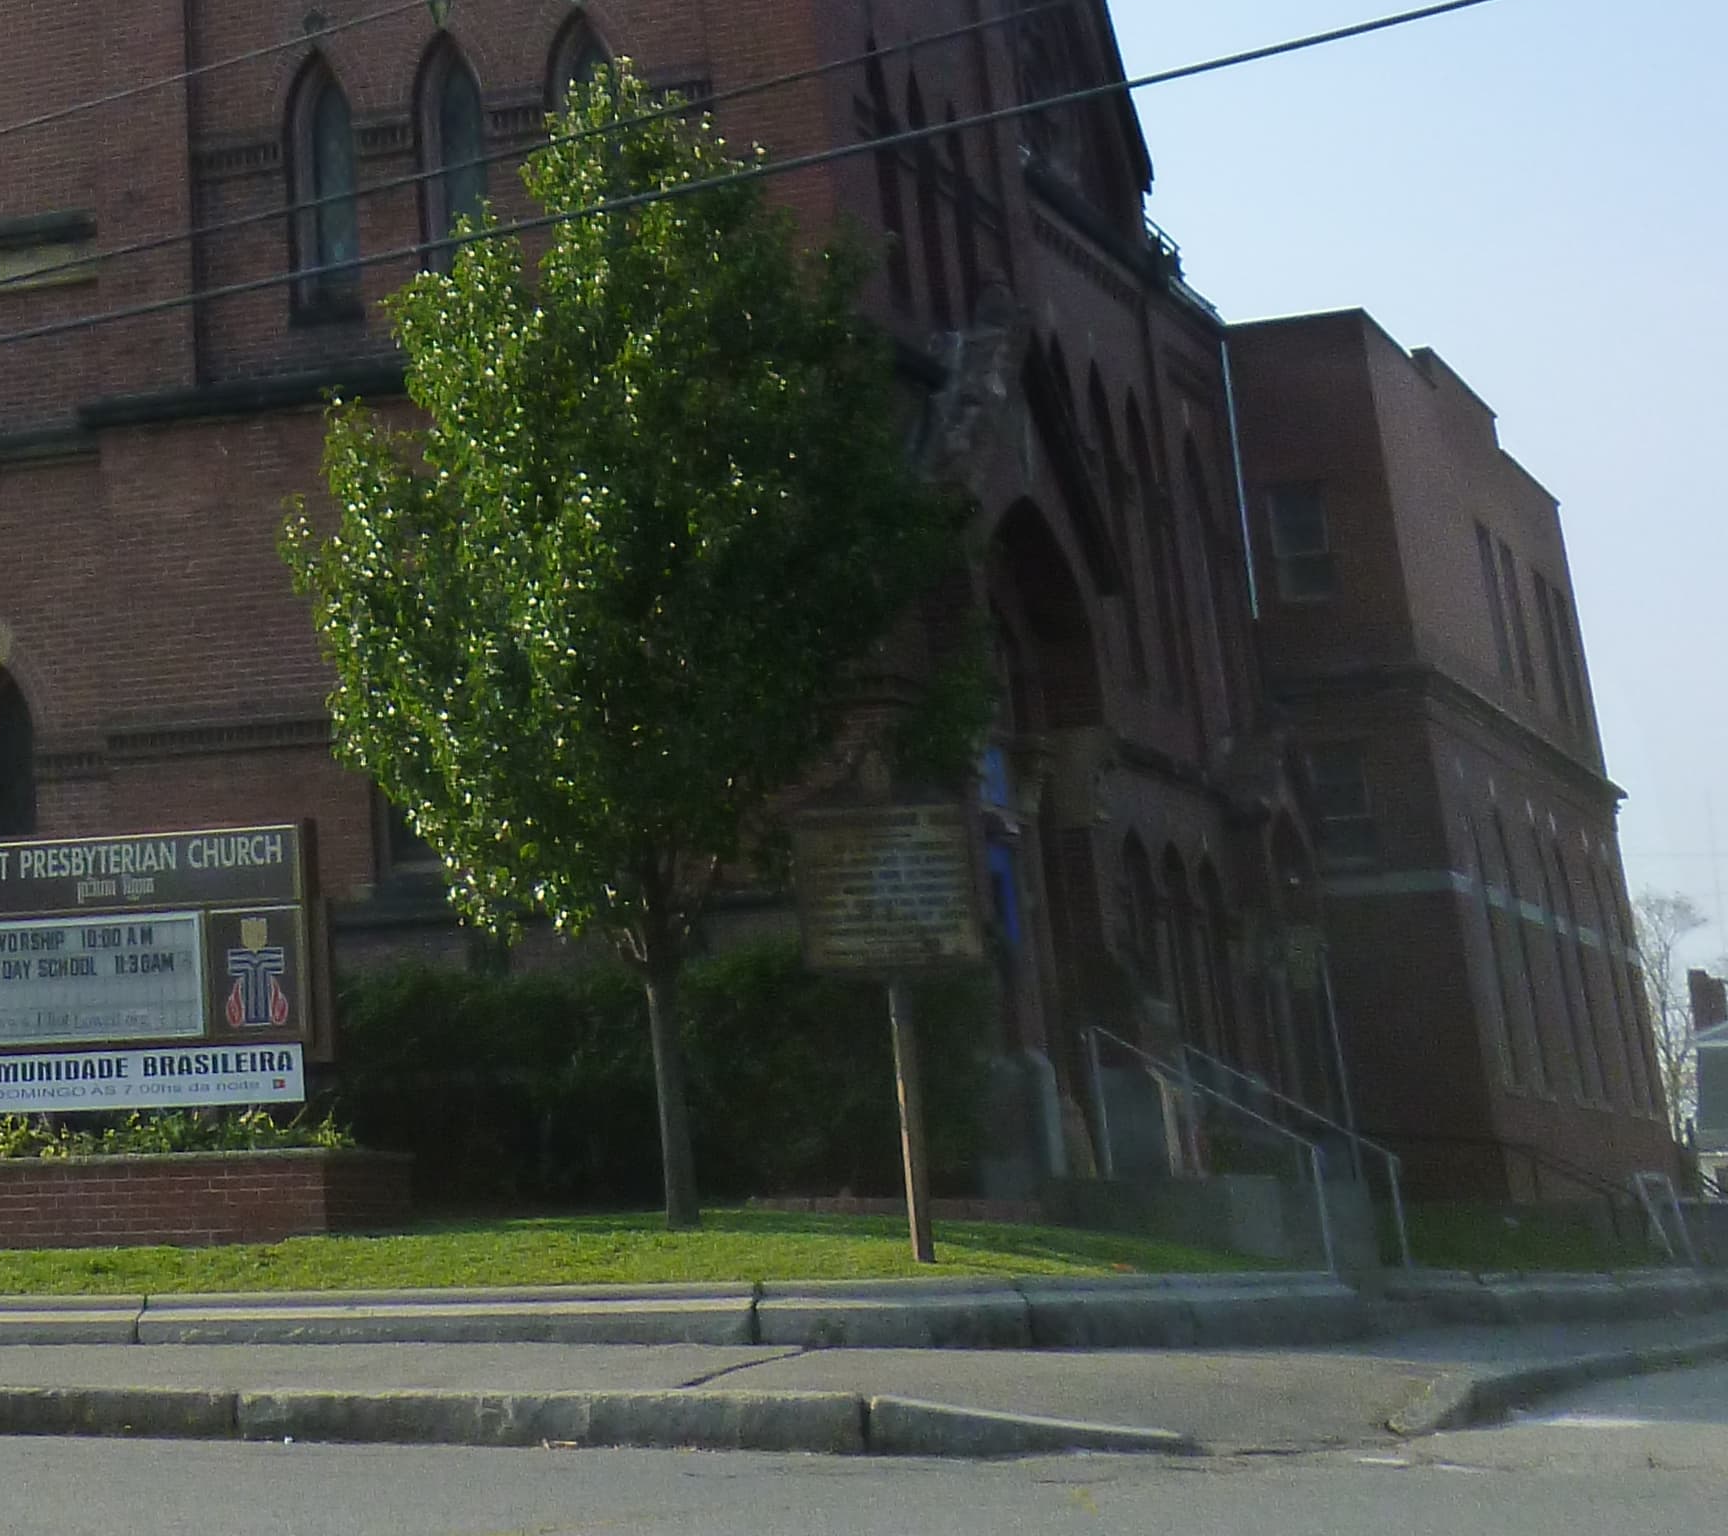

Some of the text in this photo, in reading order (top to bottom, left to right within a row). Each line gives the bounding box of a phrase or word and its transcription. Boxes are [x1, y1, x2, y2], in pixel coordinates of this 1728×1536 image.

[20, 841, 177, 879] PRESBYTERIAN
[187, 833, 283, 869] CHURCH
[81, 928, 122, 948] 10:00
[38, 955, 98, 978] SCHOOL
[142, 1050, 294, 1078] BRASILEIRA
[188, 1081, 210, 1093] da
[217, 1079, 260, 1092] noite
